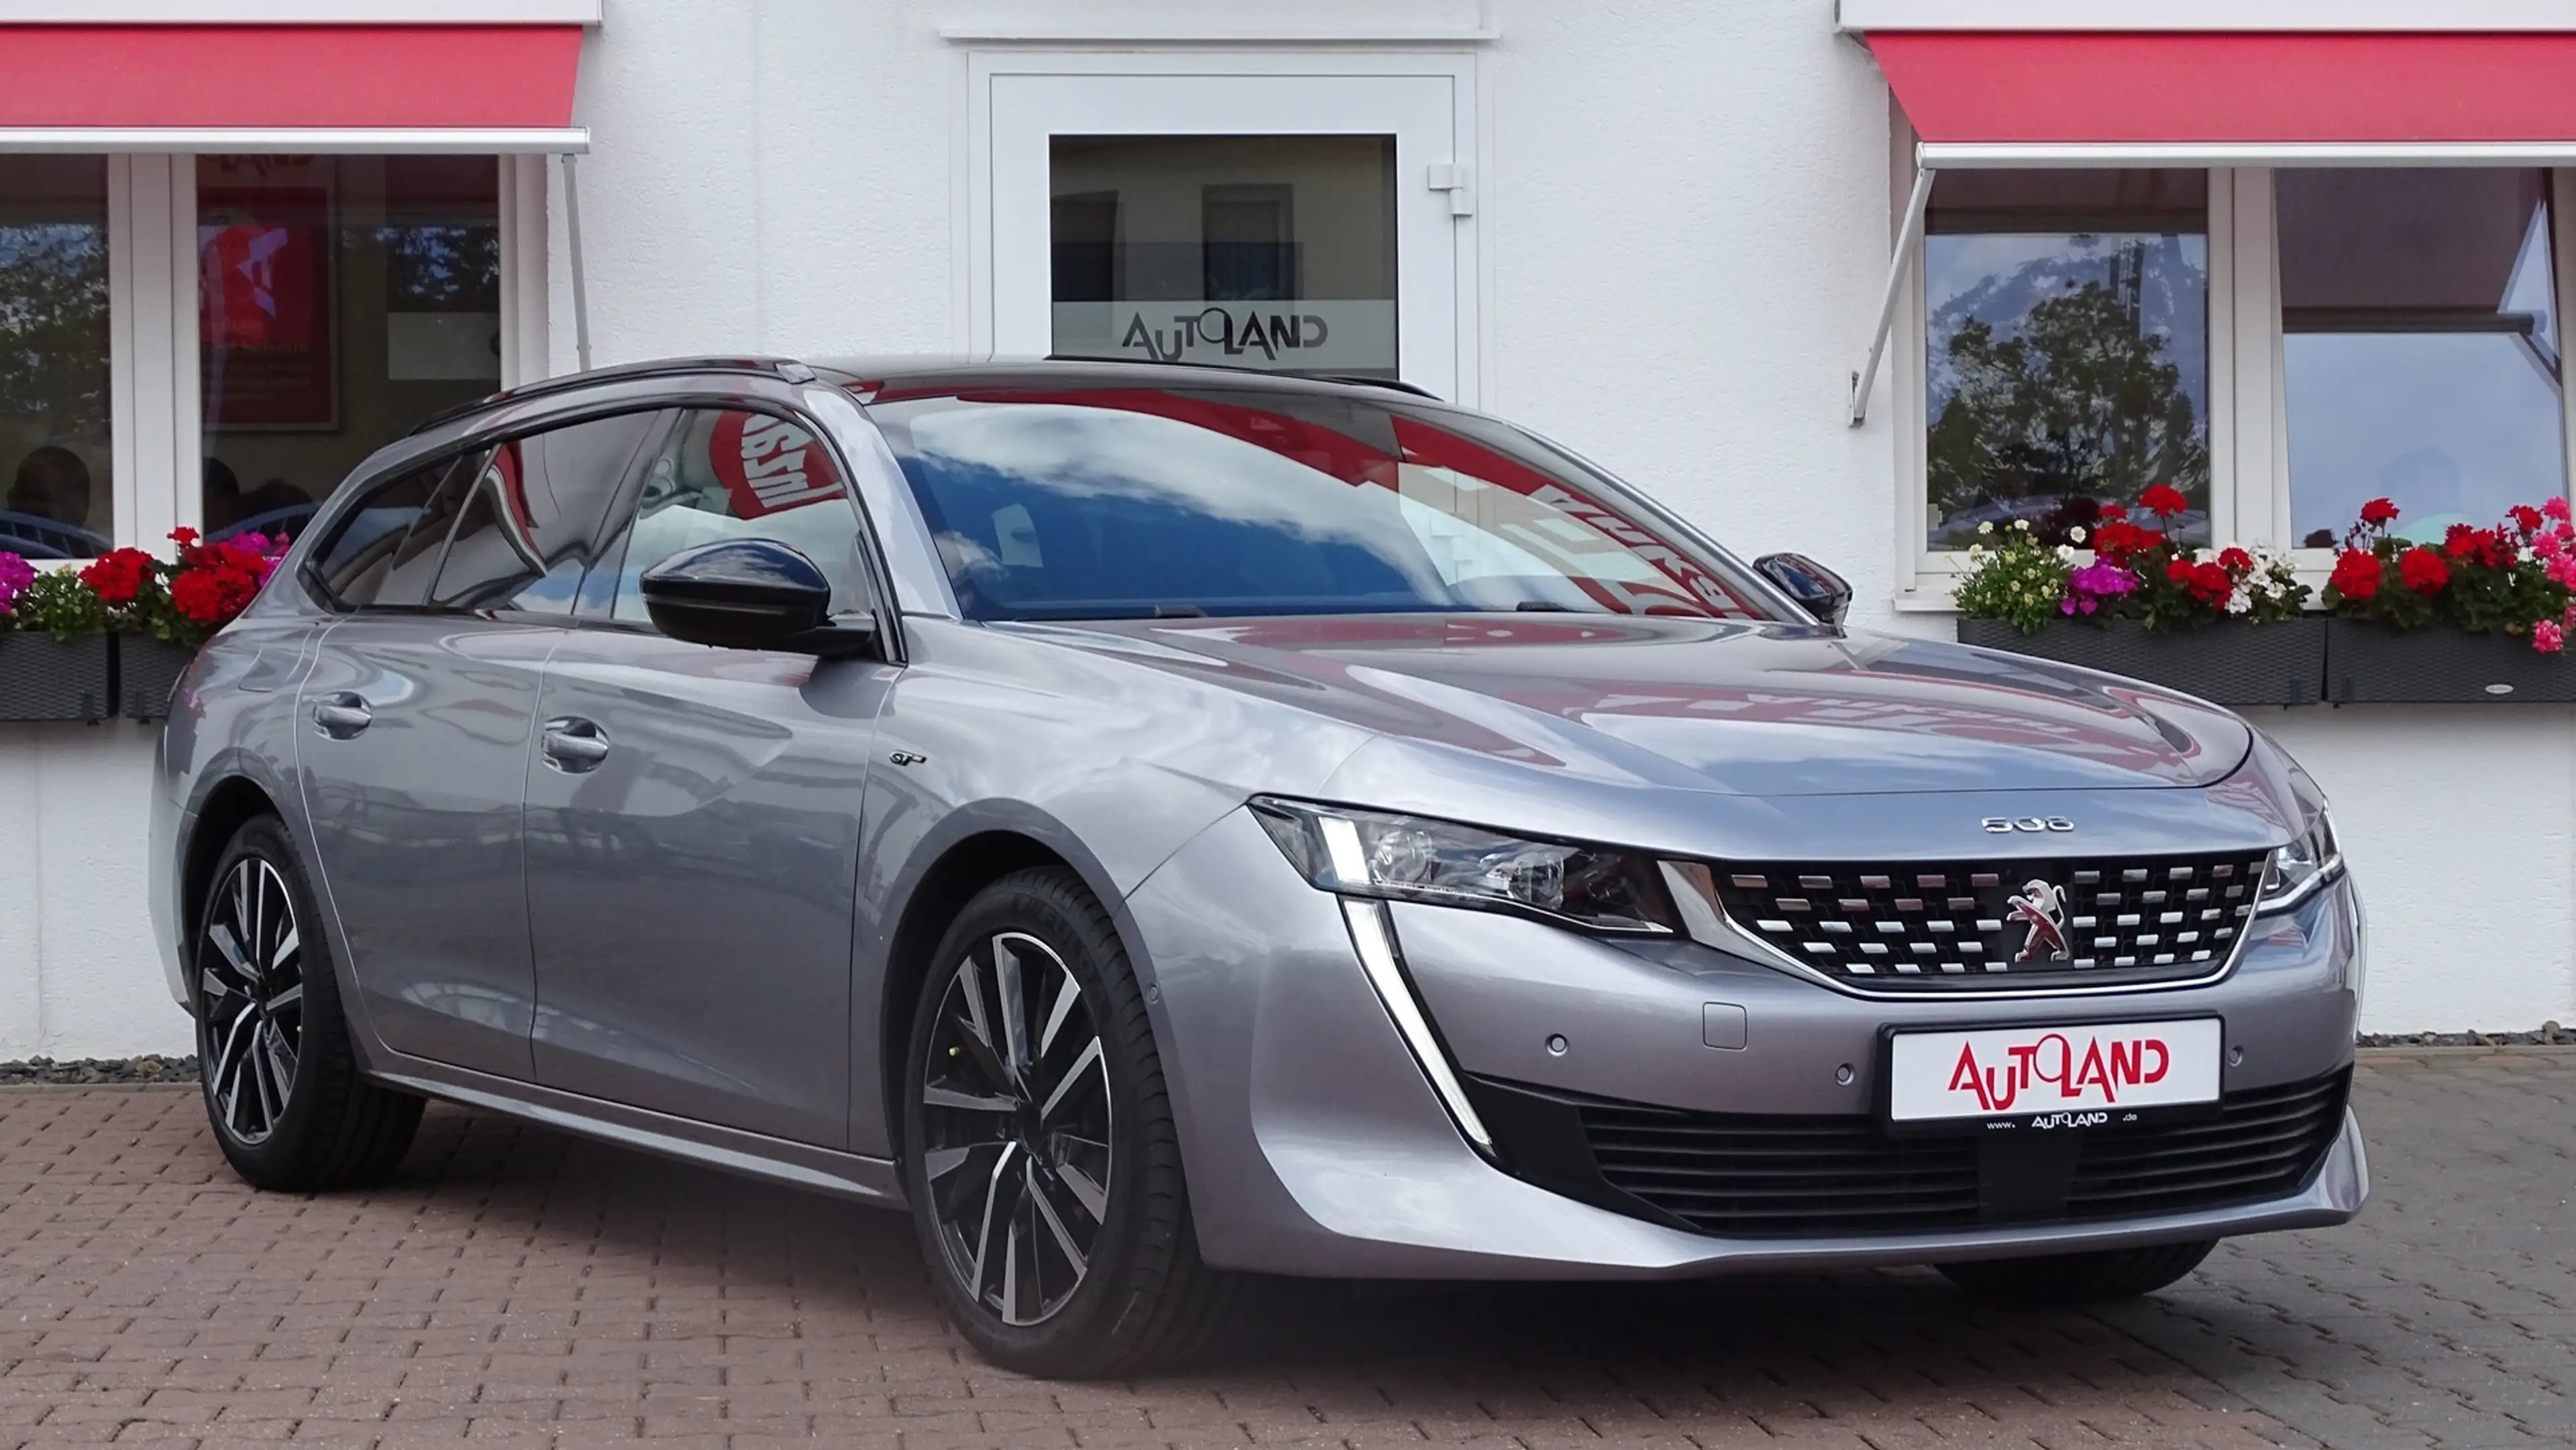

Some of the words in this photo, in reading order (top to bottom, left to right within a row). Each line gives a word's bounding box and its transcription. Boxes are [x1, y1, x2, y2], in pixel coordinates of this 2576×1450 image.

[1122, 308, 1328, 361] AUTOLAND
[1981, 816, 2074, 833] 508
[1948, 1034, 2169, 1110] AUTOLAND
[2031, 1112, 2108, 1129] AUTOLAND
